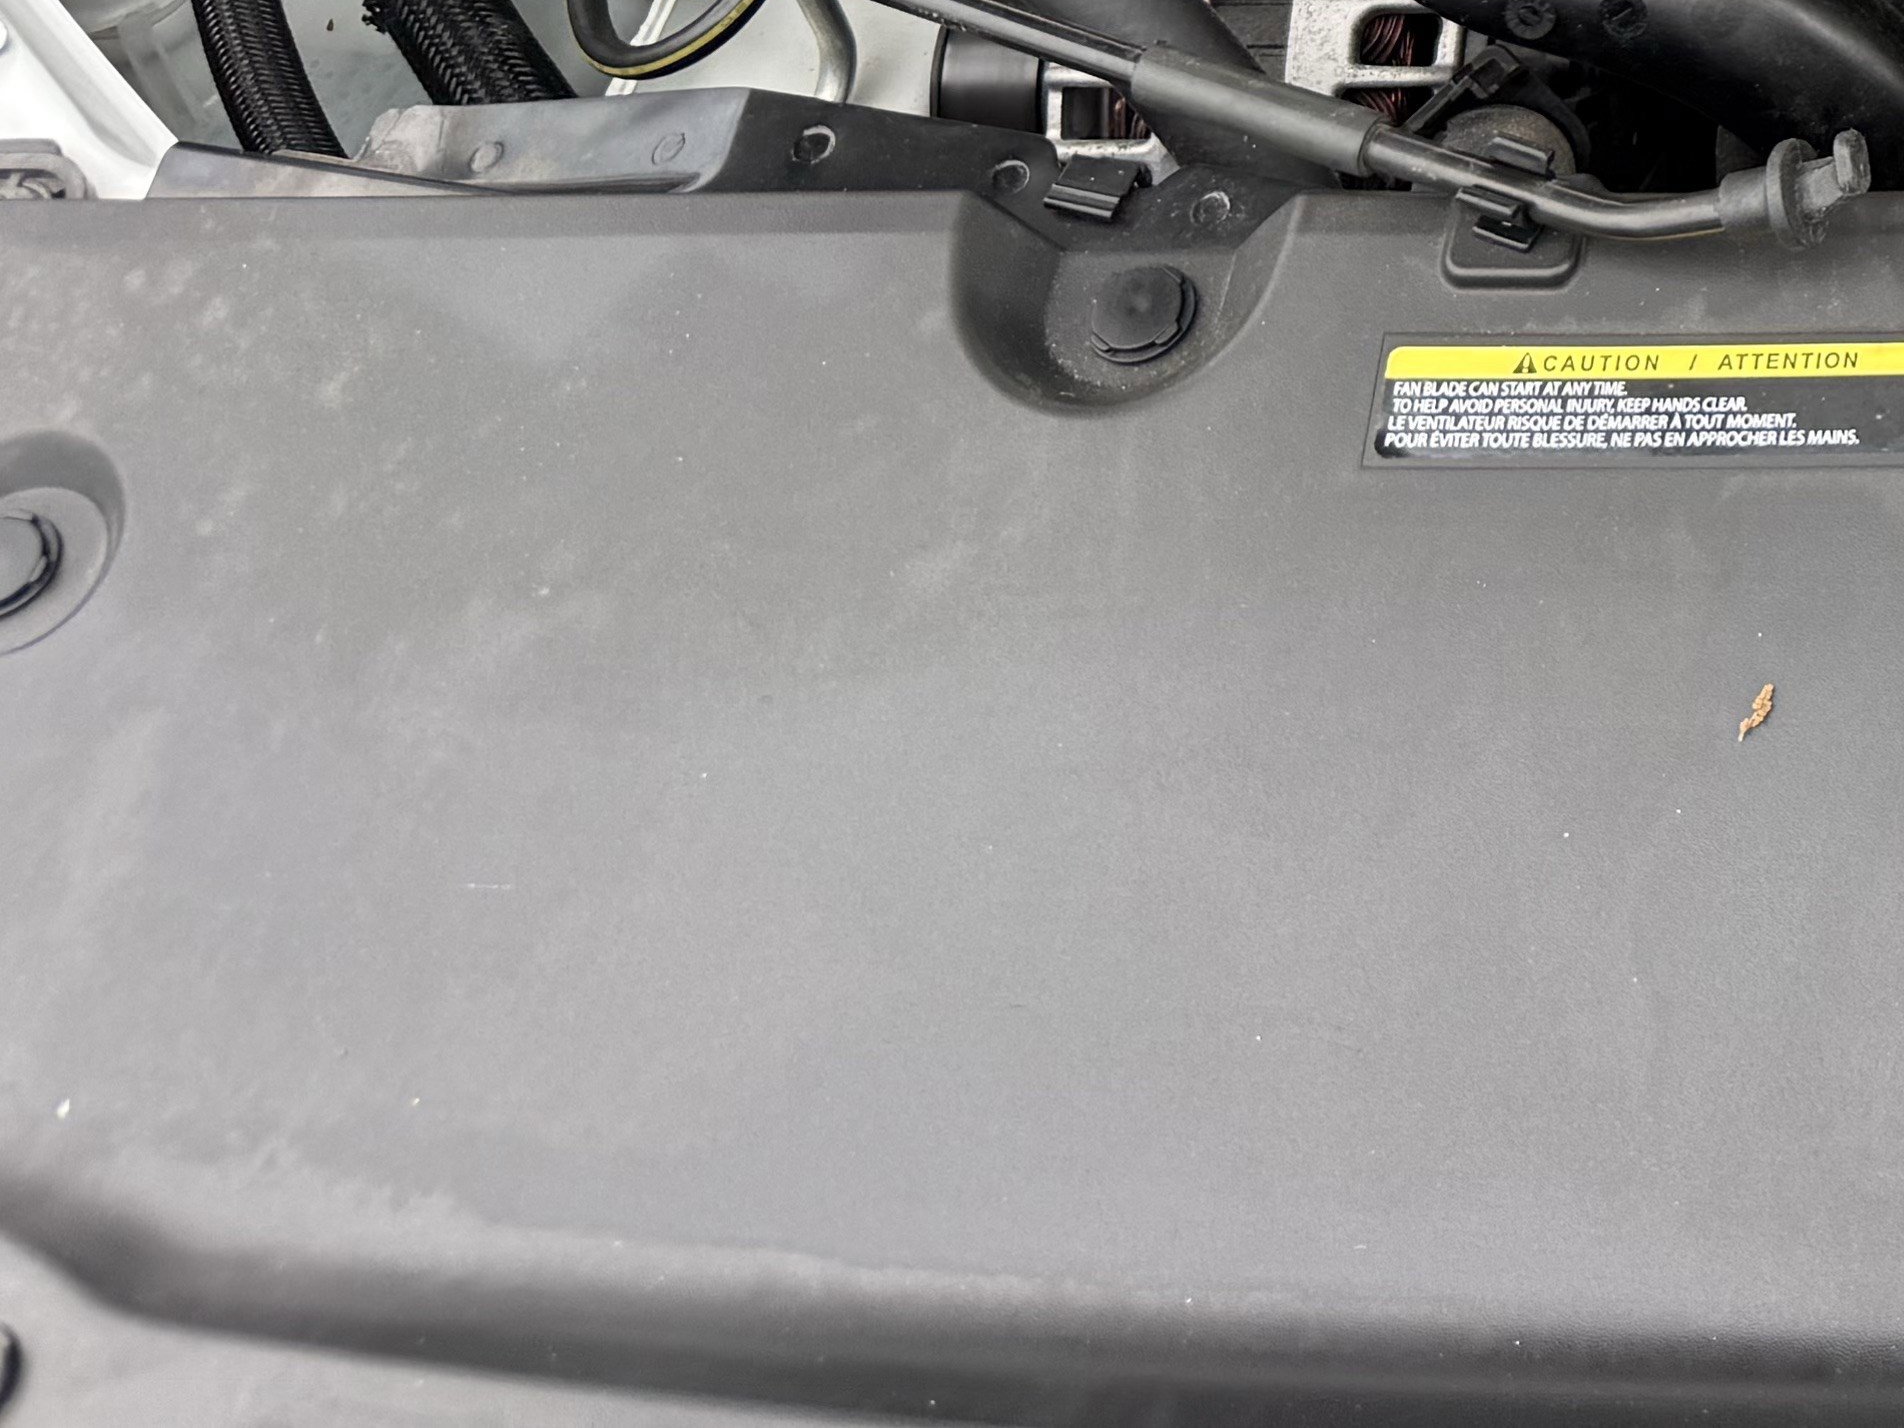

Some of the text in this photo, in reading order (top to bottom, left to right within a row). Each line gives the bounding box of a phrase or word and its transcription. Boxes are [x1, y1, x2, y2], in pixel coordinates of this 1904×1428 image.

[1543, 352, 1859, 373] CAUTION / ATTENTION
[1393, 381, 1628, 397] FAN BLADE CAN START AT ANY TIME.
[1393, 397, 1748, 414] TO HELP AVOID PERSONAL INJURY, KEEP HANDS CLEAR.
[1388, 412, 1797, 430] LE VENTILATEUR RISQUE DE DÉMARRER À TOUT MOMENT.
[1384, 429, 1860, 449] POUR ÉVITER TOUTE BLESSURE, NE PAS EN APPROCHER LES MAINS.
